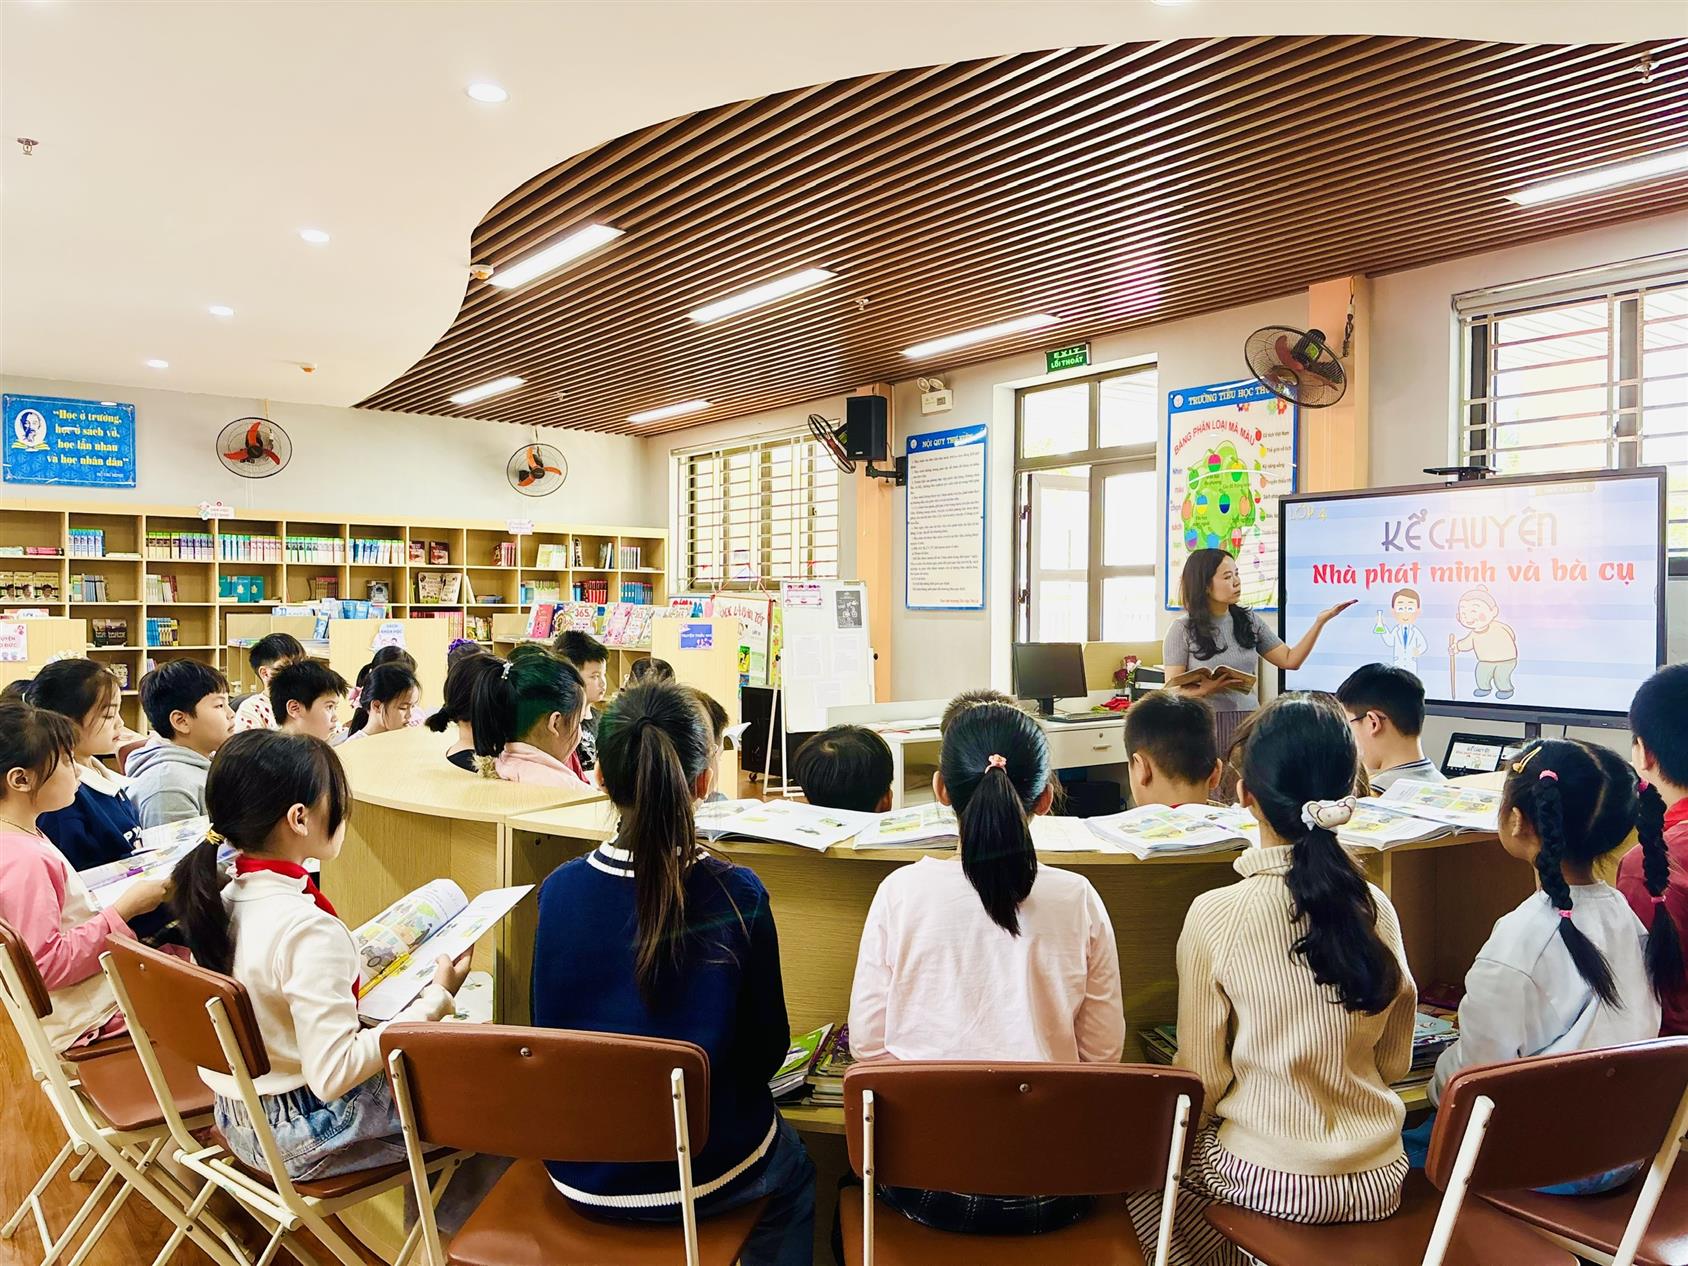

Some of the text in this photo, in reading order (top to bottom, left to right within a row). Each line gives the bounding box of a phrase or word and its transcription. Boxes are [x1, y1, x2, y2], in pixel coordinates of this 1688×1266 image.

[1054, 348, 1080, 358] EXIT
[1061, 355, 1083, 367] THOÁT
[1188, 393, 1217, 405] TRƯỜNG
[1238, 387, 1254, 399] HỌC
[933, 438, 945, 447] QUY
[1380, 505, 1556, 553] KỂ CHUYỆN
[1312, 558, 1636, 591] Nhà phát minh và bà cụ
